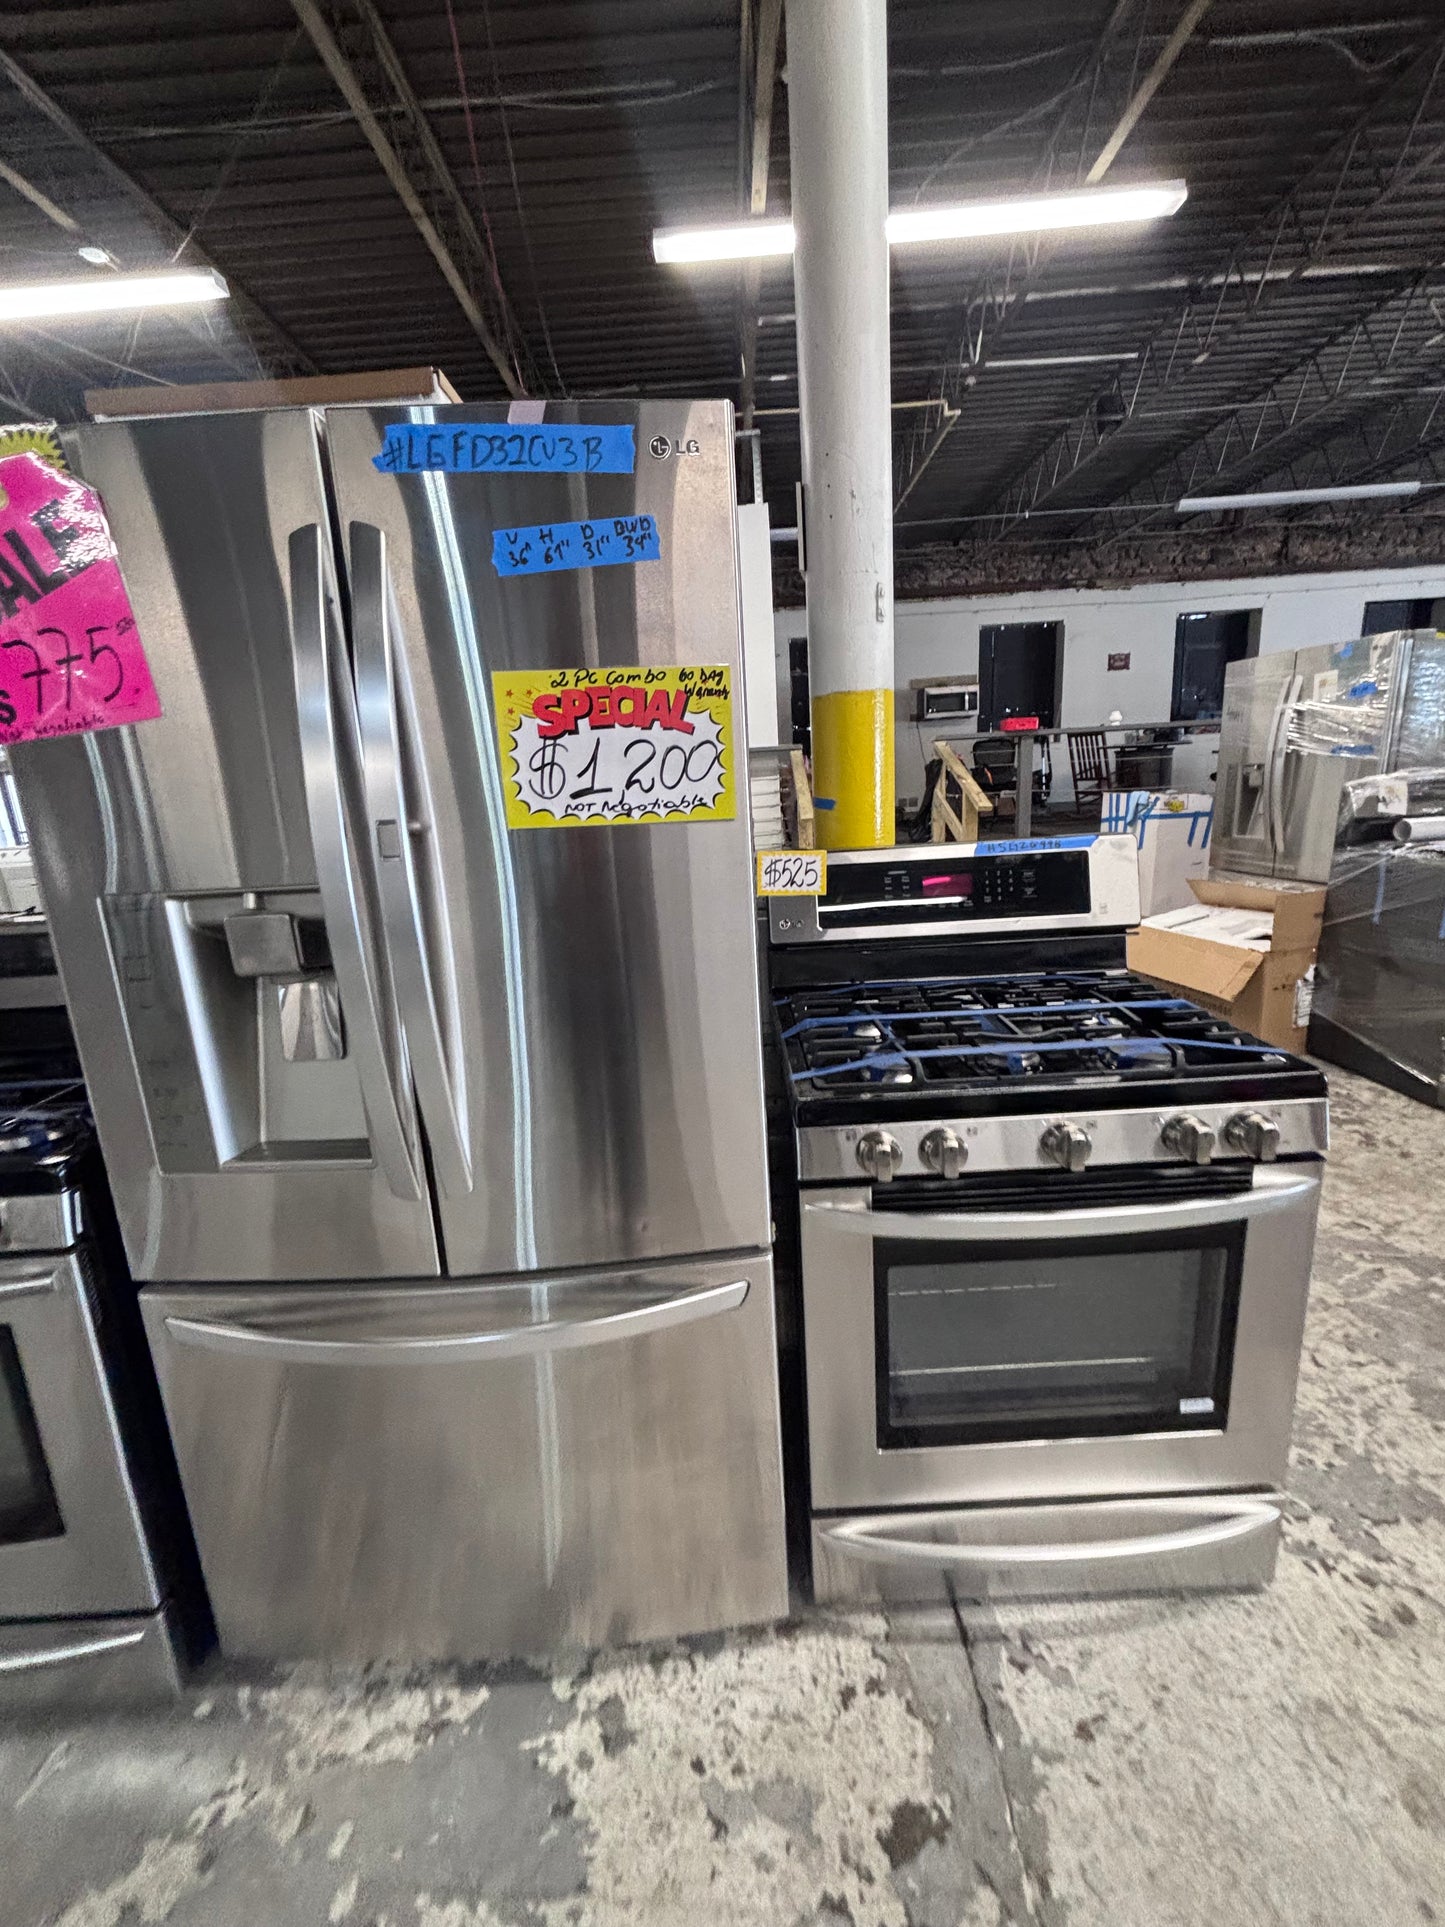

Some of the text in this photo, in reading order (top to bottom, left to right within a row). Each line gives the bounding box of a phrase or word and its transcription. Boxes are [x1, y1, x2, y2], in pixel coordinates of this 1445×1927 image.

[676, 440, 700, 456] LG
[539, 528, 553, 544] H
[580, 524, 594, 540] D
[0, 499, 96, 618] ALE
[550, 671, 569, 688] 2
[679, 667, 694, 682] 60
[532, 685, 695, 738] SPECIAL
[564, 802, 597, 814] NOT
[764, 857, 818, 888] $525
